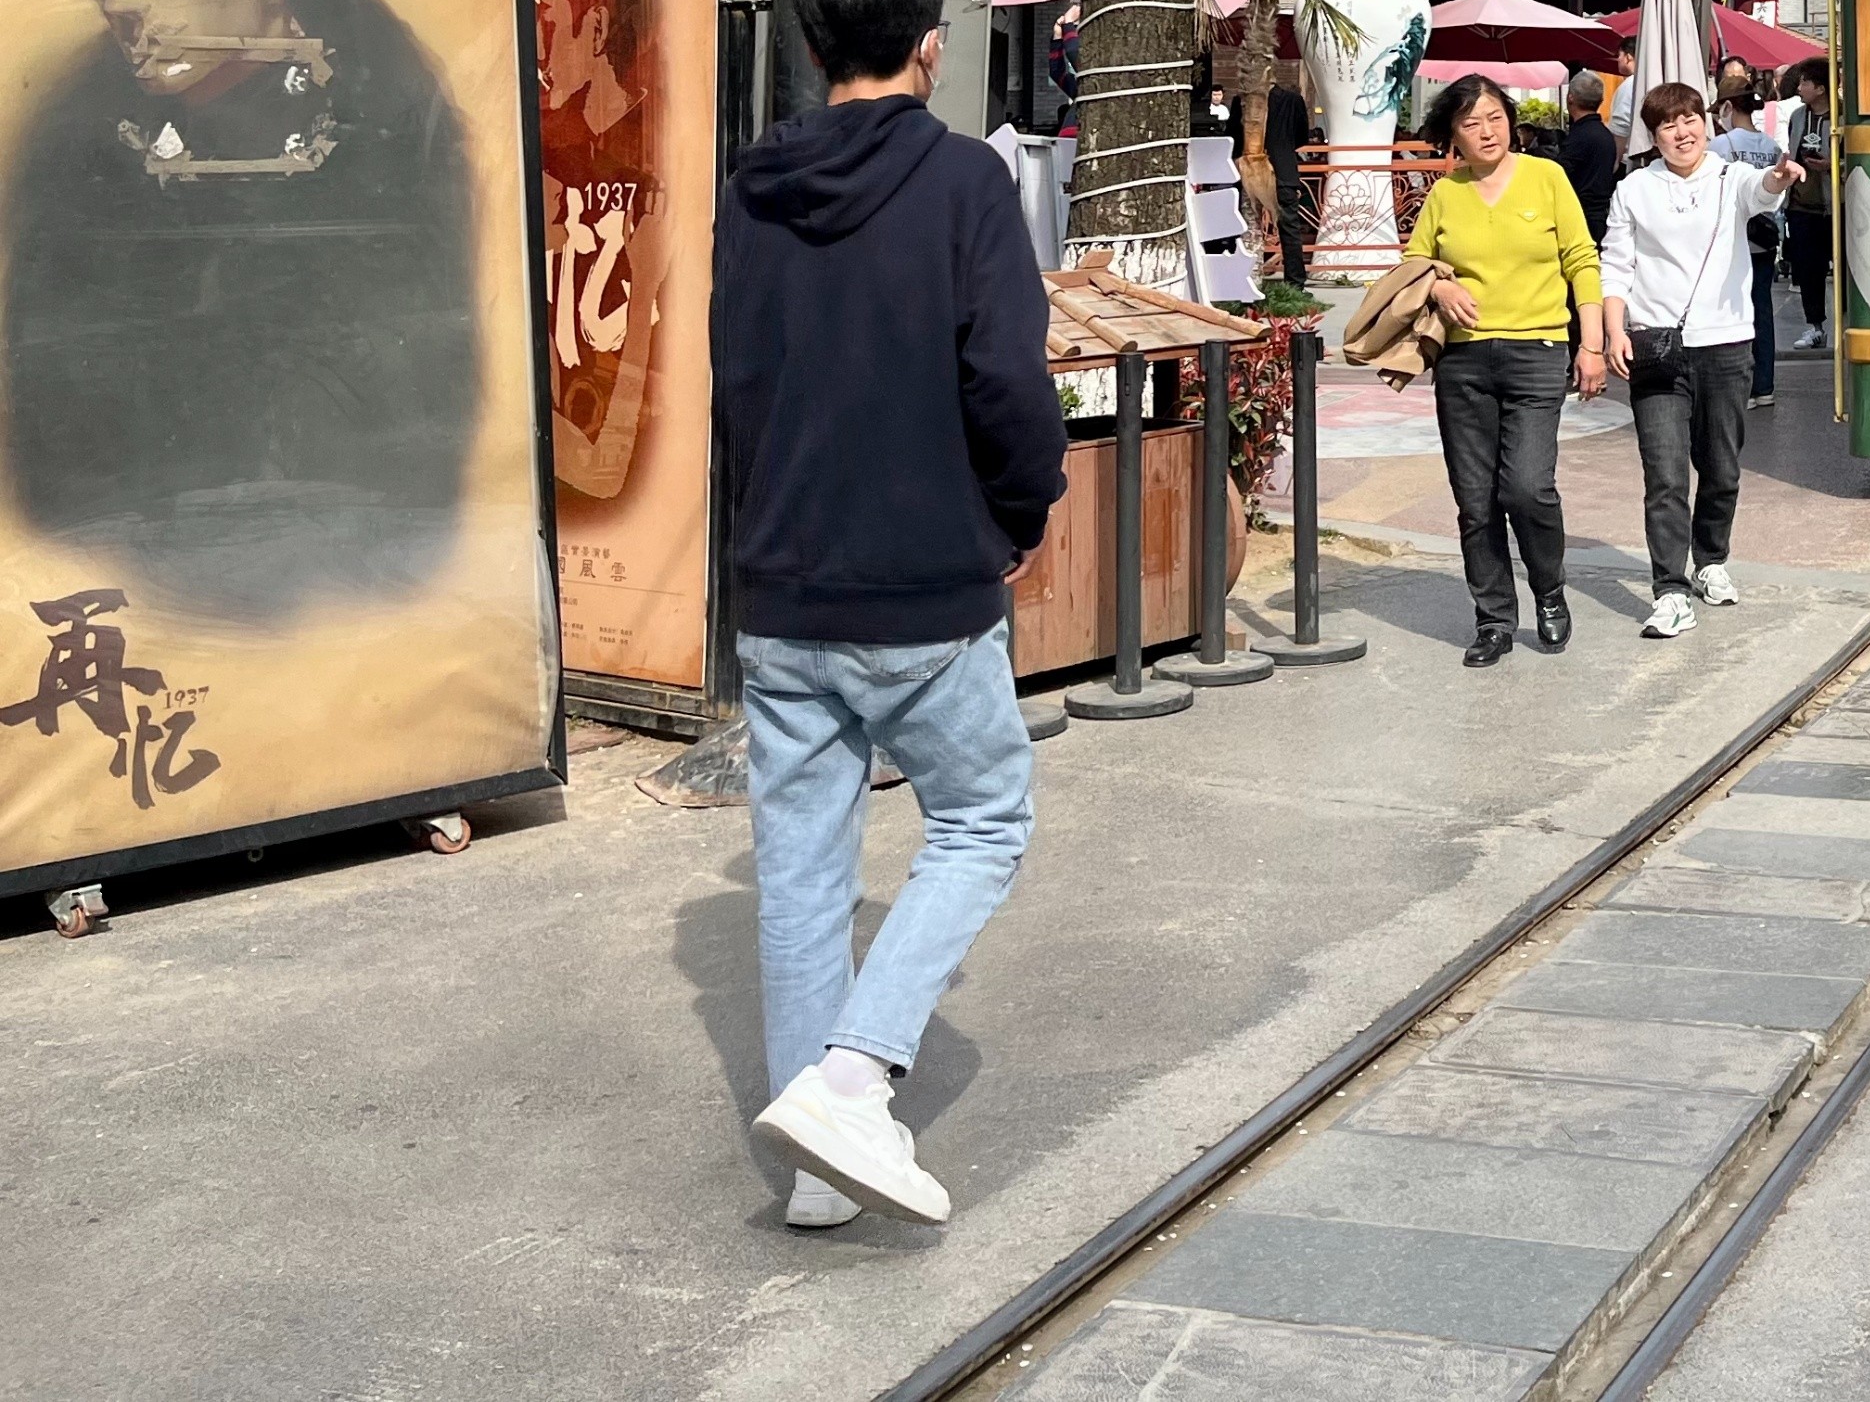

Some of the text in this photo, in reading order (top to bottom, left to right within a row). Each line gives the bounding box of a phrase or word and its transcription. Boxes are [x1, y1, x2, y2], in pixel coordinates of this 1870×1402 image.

[584, 182, 637, 211] 1937
[0, 588, 222, 810] 再忆
[163, 685, 210, 710] 1937
